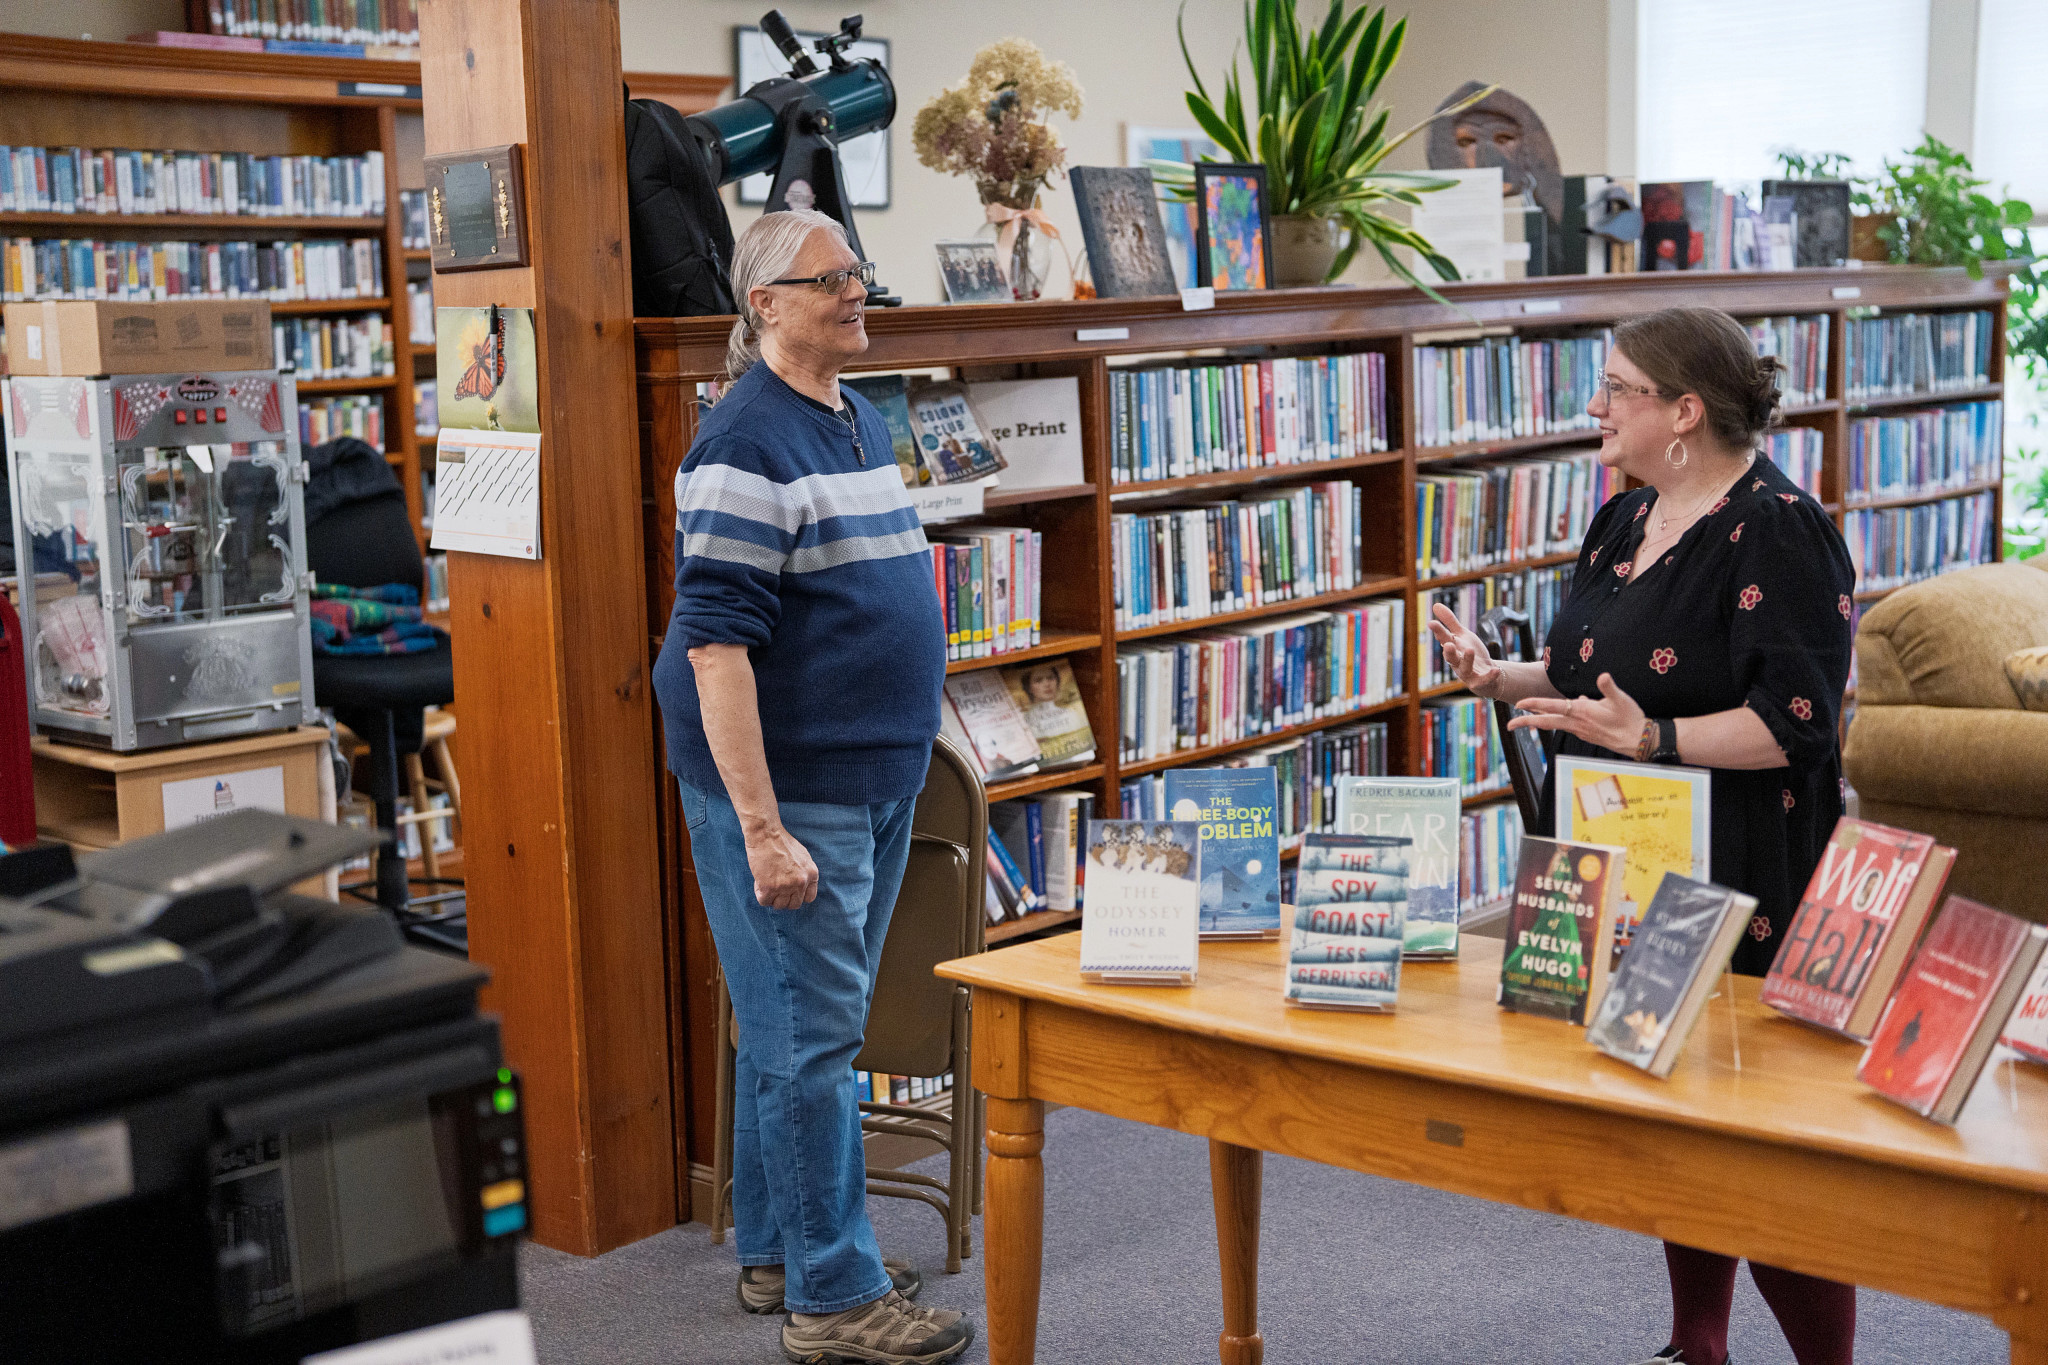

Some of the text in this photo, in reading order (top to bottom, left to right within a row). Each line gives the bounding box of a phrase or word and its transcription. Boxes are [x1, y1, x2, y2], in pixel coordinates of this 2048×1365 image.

[918, 403, 965, 423] COLONY
[933, 420, 965, 436] CLUB
[1016, 422, 1067, 437] Print
[922, 499, 944, 510] Large
[945, 496, 963, 506] Print
[1209, 796, 1233, 806] THE
[1350, 787, 1452, 798] FREDRIK BACKMAN
[1170, 806, 1272, 822] THREE-BODY
[1197, 821, 1273, 840] OBLEM
[1350, 812, 1449, 854] BEAR
[1340, 853, 1373, 873] THE
[1534, 875, 1583, 895] SEVEN
[1815, 841, 1920, 919] Wolf
[1122, 886, 1160, 899] THE
[1330, 878, 1378, 903] SPY
[1095, 905, 1183, 920] ODYSSEY
[1517, 892, 1594, 919] HUSBANDS
[1108, 926, 1167, 938] HOMER
[1311, 910, 1390, 938] COAST
[1518, 931, 1583, 955] EVELYN
[1771, 901, 1886, 999] Hall
[1325, 946, 1367, 963] TESS
[1521, 954, 1573, 978] HUGO
[1298, 968, 1390, 990] GERRITSEN
